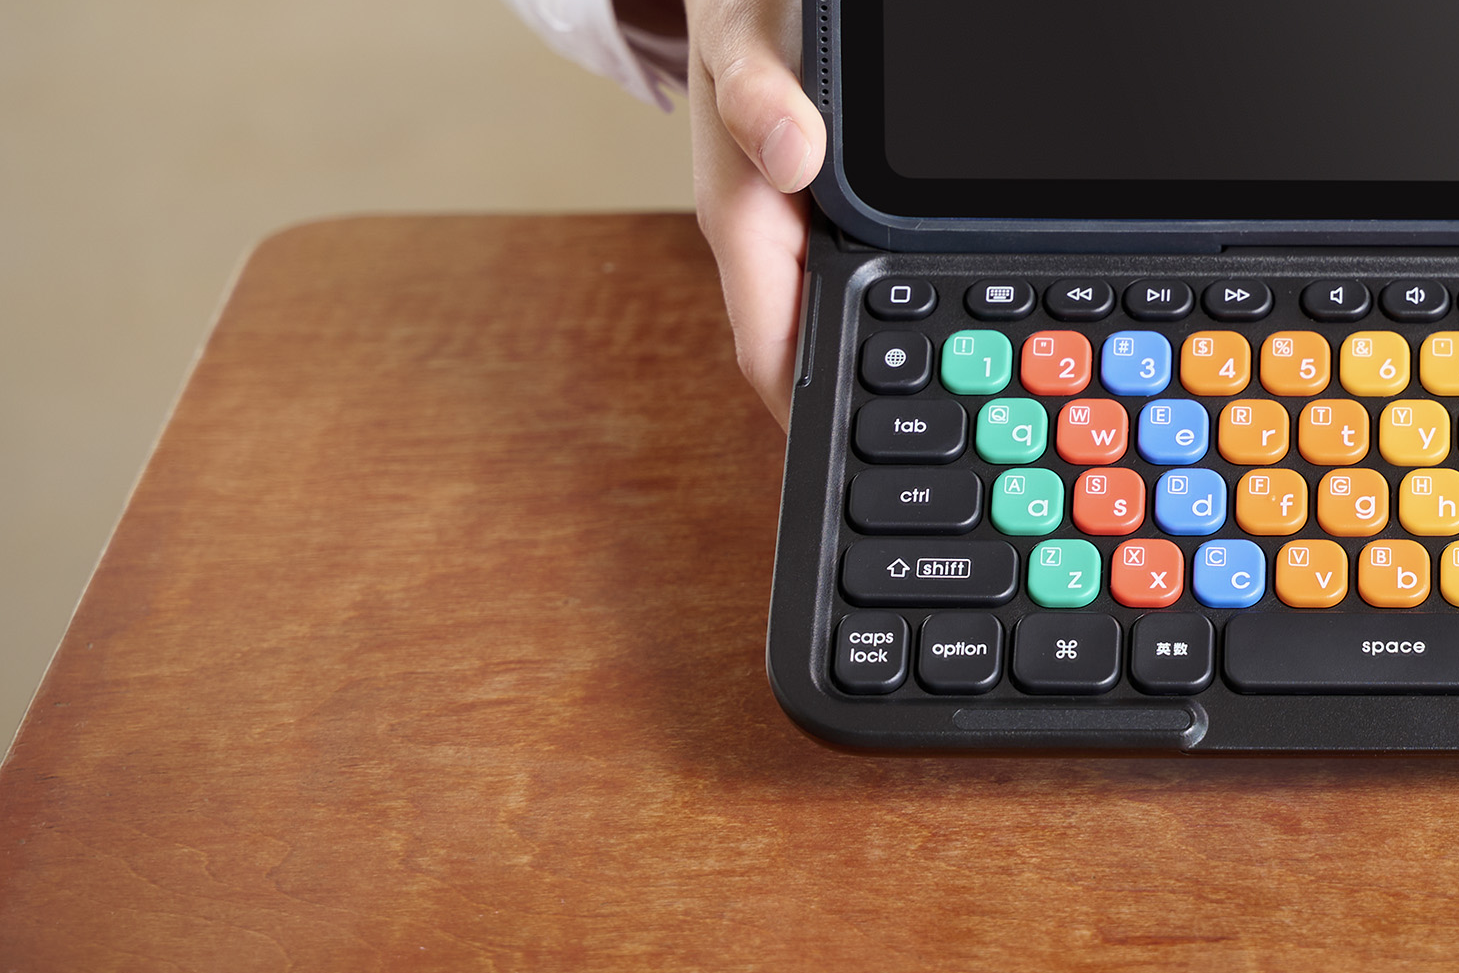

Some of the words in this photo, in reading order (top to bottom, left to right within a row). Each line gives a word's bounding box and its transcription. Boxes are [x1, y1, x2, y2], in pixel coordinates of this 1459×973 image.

[1118, 340, 1129, 354] #
[1198, 340, 1209, 354] $
[1275, 340, 1291, 355] %
[1356, 340, 1369, 355] &
[983, 357, 992, 378] 1
[1058, 357, 1076, 379] 2
[1139, 357, 1156, 379] 3
[1218, 357, 1236, 379] 4
[1299, 358, 1317, 380] 5
[1379, 358, 1397, 380] 6
[991, 407, 1007, 422] Q
[1071, 408, 1088, 422] W
[1156, 408, 1166, 422] E
[1236, 408, 1247, 423] R
[1317, 408, 1326, 423] T
[1396, 409, 1408, 424] Y
[894, 418, 927, 433] tab
[1011, 424, 1033, 446] q
[1090, 428, 1117, 446] w
[1175, 428, 1195, 446] e
[1261, 429, 1276, 447] r
[1340, 425, 1356, 447] t
[1418, 427, 1437, 450] y
[1008, 478, 1021, 492] A
[1091, 478, 1101, 492] S
[1171, 478, 1185, 492] D
[1255, 478, 1264, 493] F
[1333, 479, 1348, 493] G
[1416, 478, 1428, 493] H
[900, 488, 930, 503] ctrl
[1027, 499, 1049, 517] a
[1113, 498, 1127, 517] s
[1191, 493, 1213, 517] d
[1279, 493, 1294, 517] f
[1354, 495, 1376, 520] g
[1438, 495, 1456, 518] h
[1046, 549, 1056, 564] Z
[1127, 549, 1141, 564] X
[1208, 549, 1223, 564] C
[1292, 549, 1305, 564] V
[1376, 549, 1387, 564] B
[922, 561, 965, 576] shift
[1067, 571, 1082, 589] z
[1149, 571, 1168, 589] x
[1231, 571, 1251, 590] c
[1315, 571, 1333, 589] v
[1397, 566, 1418, 590] b
[849, 632, 894, 647] caps
[850, 648, 888, 663] lock
[932, 641, 987, 658] option
[1156, 642, 1188, 656] 英数
[1361, 641, 1426, 656] space
